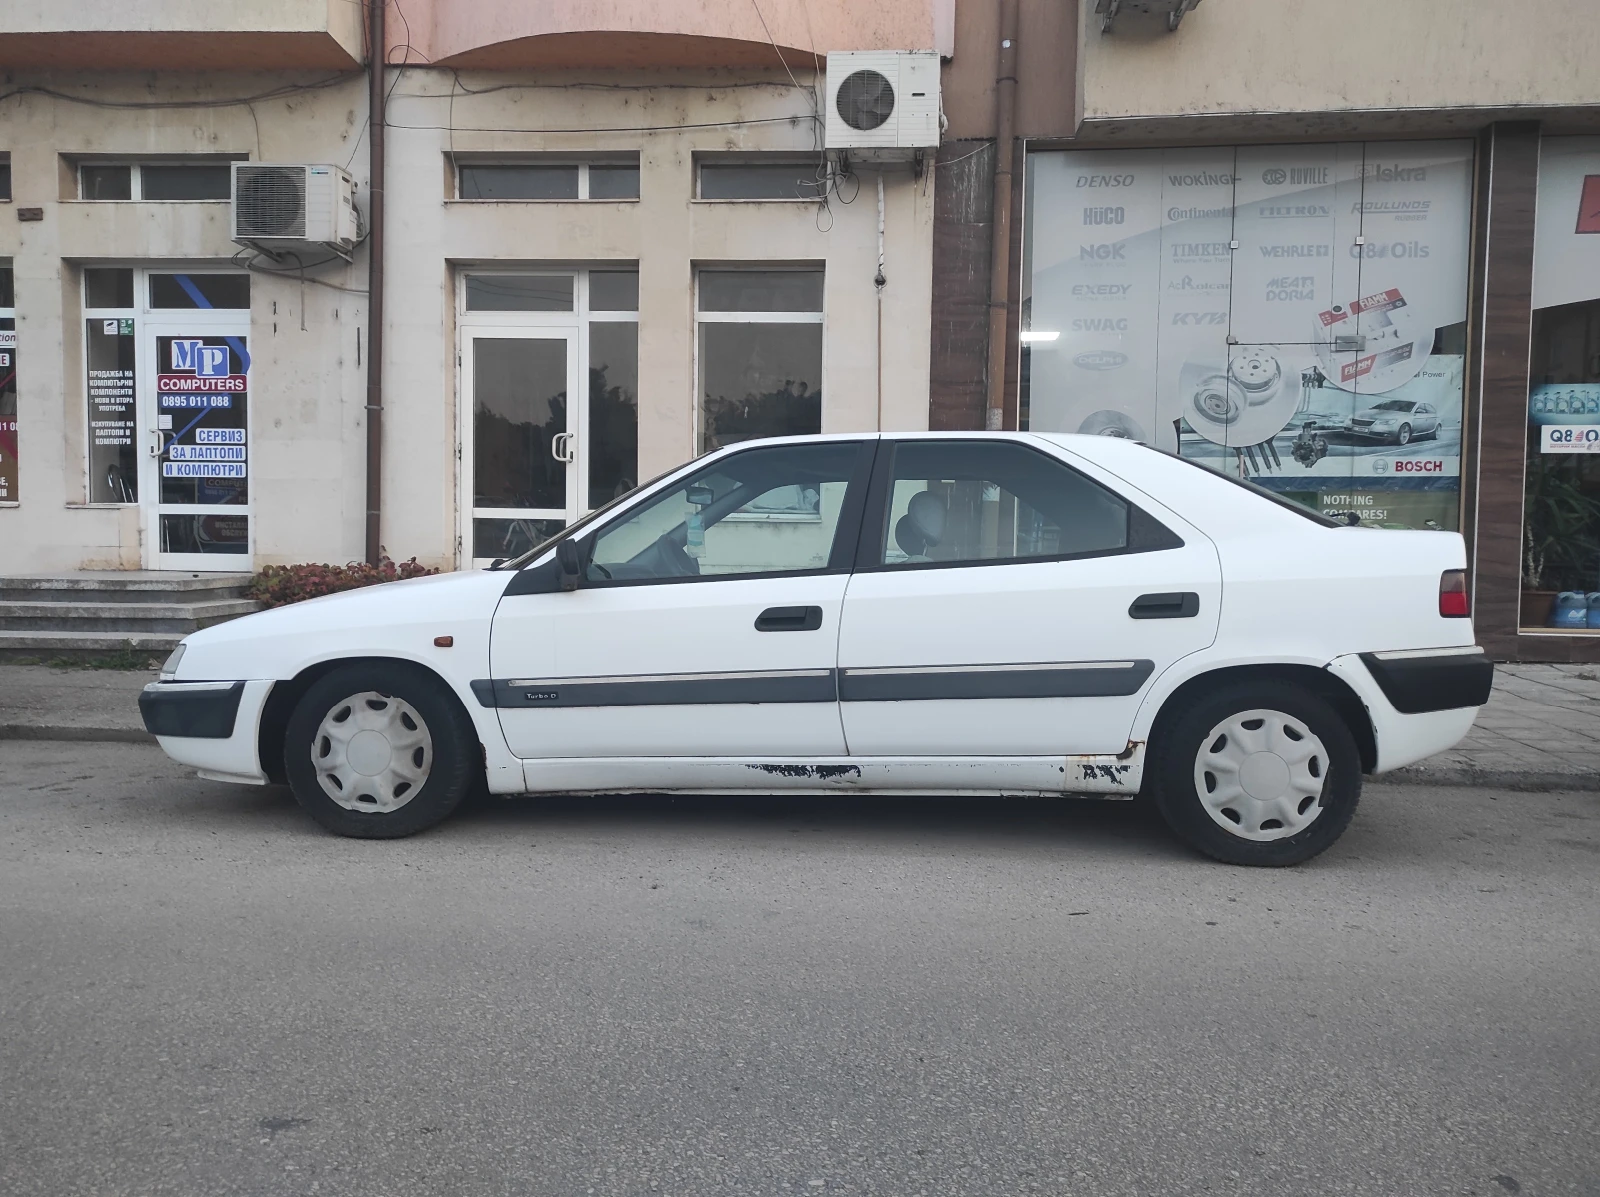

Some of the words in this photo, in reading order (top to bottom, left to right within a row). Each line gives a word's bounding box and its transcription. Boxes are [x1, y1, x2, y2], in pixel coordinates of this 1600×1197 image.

[1290, 167, 1328, 185] RUVILLE
[1376, 164, 1427, 182] Iskra
[1076, 174, 1134, 188] DENSO
[1080, 244, 1126, 260] NGK
[1171, 242, 1230, 257] TIMKEN
[1259, 244, 1314, 258] WEHRLE
[1391, 240, 1430, 259] Oils
[1071, 284, 1132, 296] EXEDY
[1359, 292, 1389, 309] FIAMM
[1071, 318, 1128, 332] SWAG
[1171, 312, 1228, 326] KYB
[89, 370, 123, 378] ПРОДАЖБА
[160, 378, 244, 390] COMPUTERS
[162, 396, 187, 406] 0895
[189, 396, 207, 406] 011
[210, 396, 229, 406] 088
[198, 430, 243, 442] СЕРВИЗ
[1550, 429, 1573, 442] Q8
[172, 447, 186, 459] ЗА
[190, 447, 243, 459] ЛАПТОПИ
[165, 464, 173, 476] И
[177, 464, 243, 476] КОМПЮТРИ
[1395, 461, 1443, 472] BOSCH
[1323, 495, 1374, 505] NOTHING
